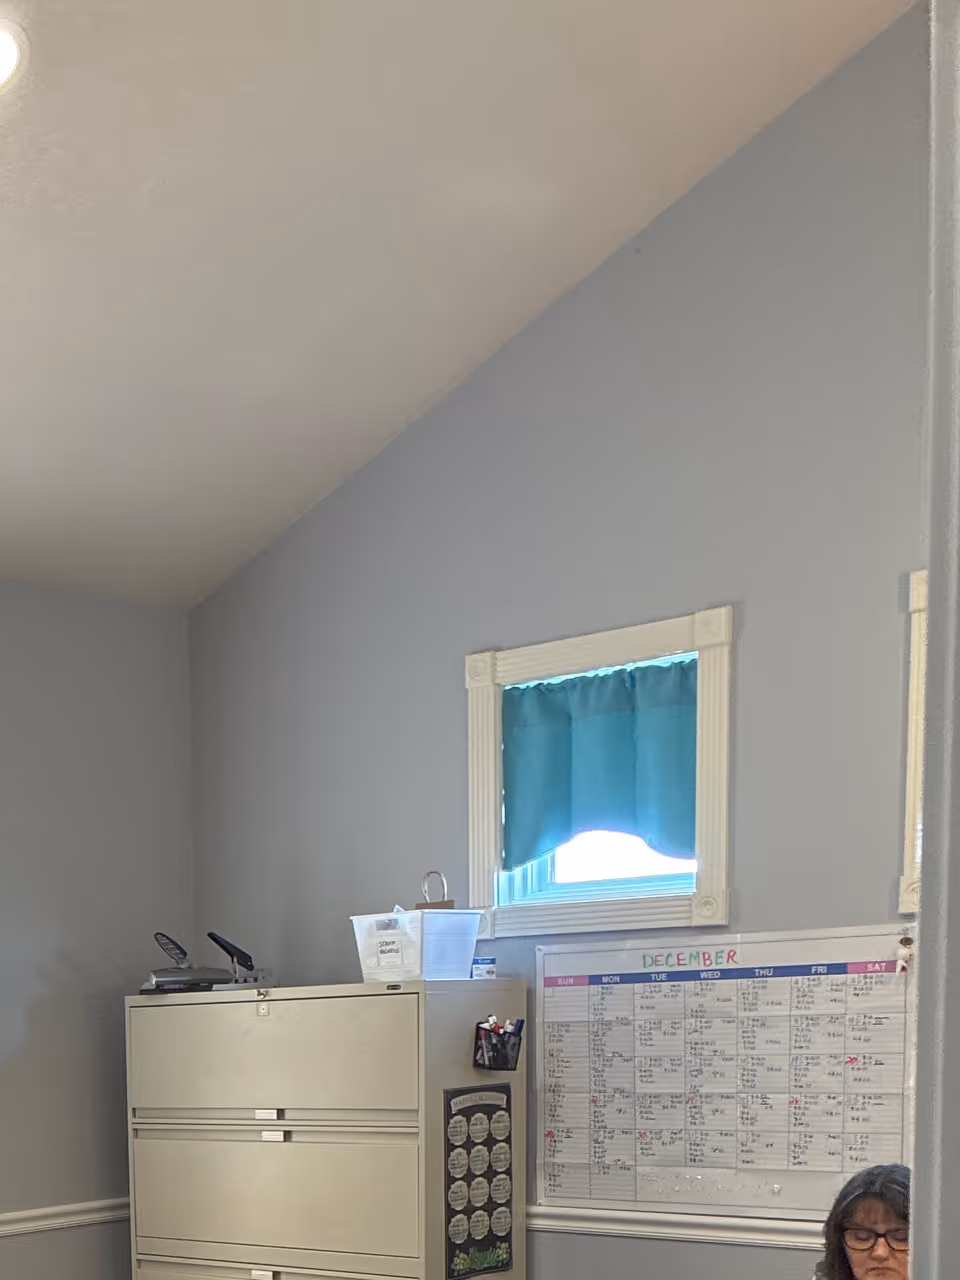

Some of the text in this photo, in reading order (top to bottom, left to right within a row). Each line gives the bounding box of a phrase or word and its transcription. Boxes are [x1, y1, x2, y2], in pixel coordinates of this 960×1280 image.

[642, 949, 738, 969] DECEMBER
[557, 977, 575, 986] SUN
[601, 975, 620, 983] MON
[650, 973, 668, 981] TUE
[700, 971, 721, 979] WED
[811, 965, 828, 974] FRI
[867, 963, 887, 971] SAT
